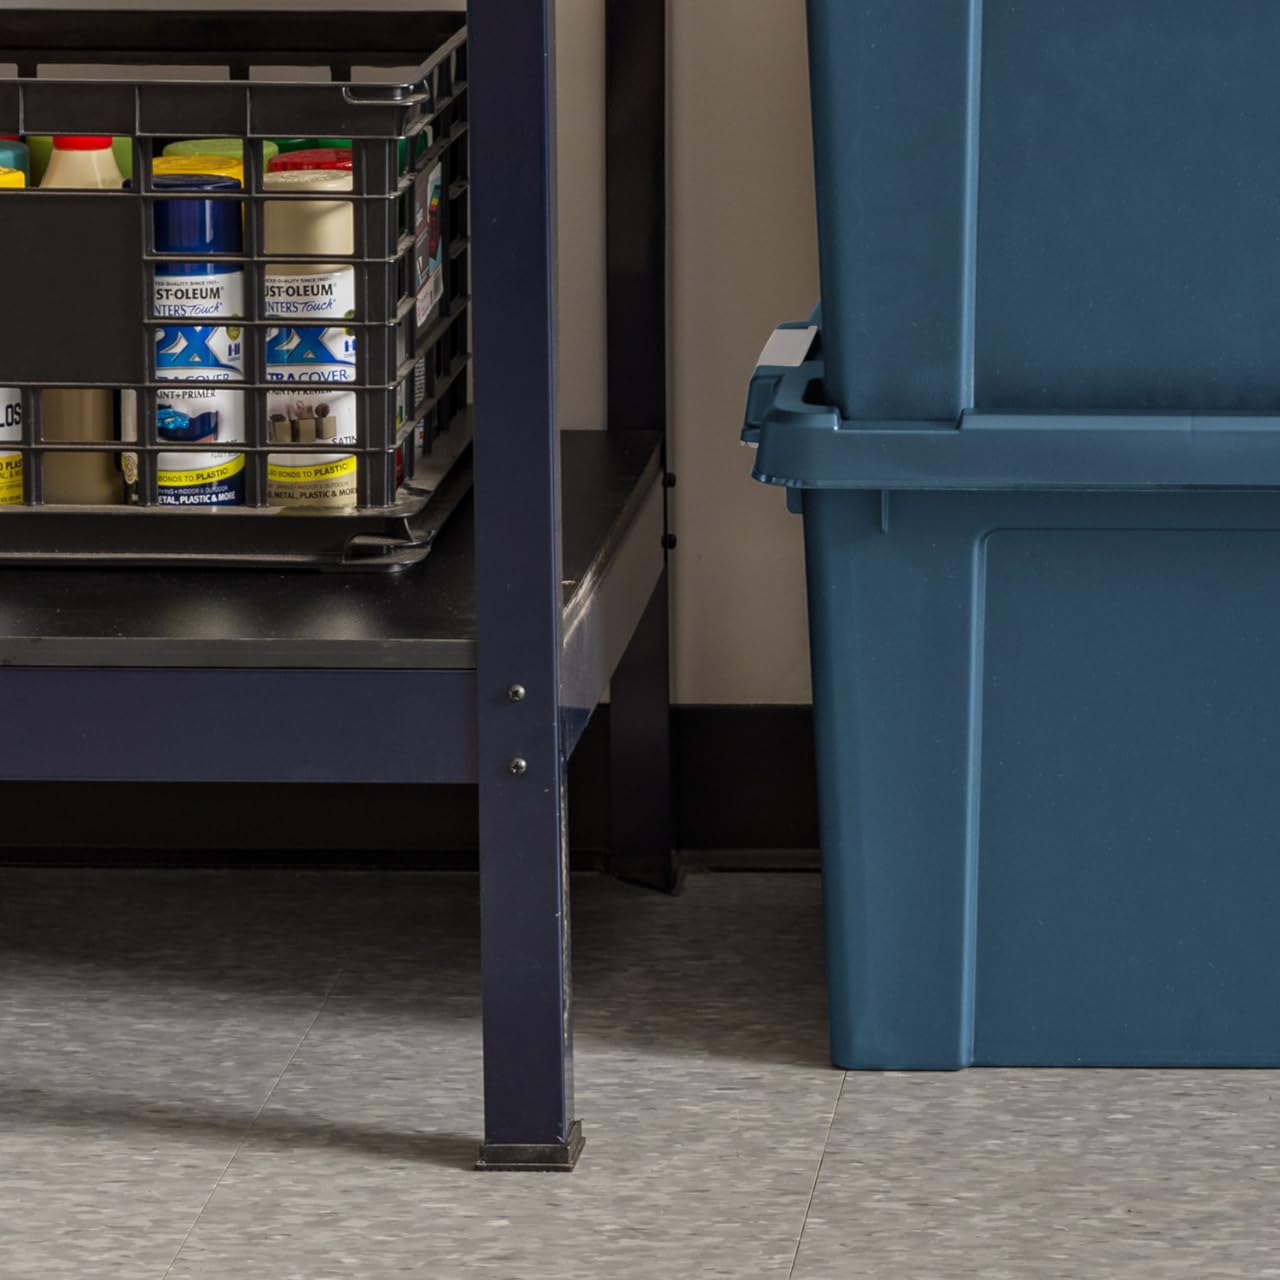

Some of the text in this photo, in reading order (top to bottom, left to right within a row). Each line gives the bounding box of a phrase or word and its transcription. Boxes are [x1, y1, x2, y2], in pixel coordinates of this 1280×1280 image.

[156, 287, 220, 300] ST-OLEUM
[265, 283, 333, 297] ST-OLEUM
[159, 495, 179, 505] ETAL,
